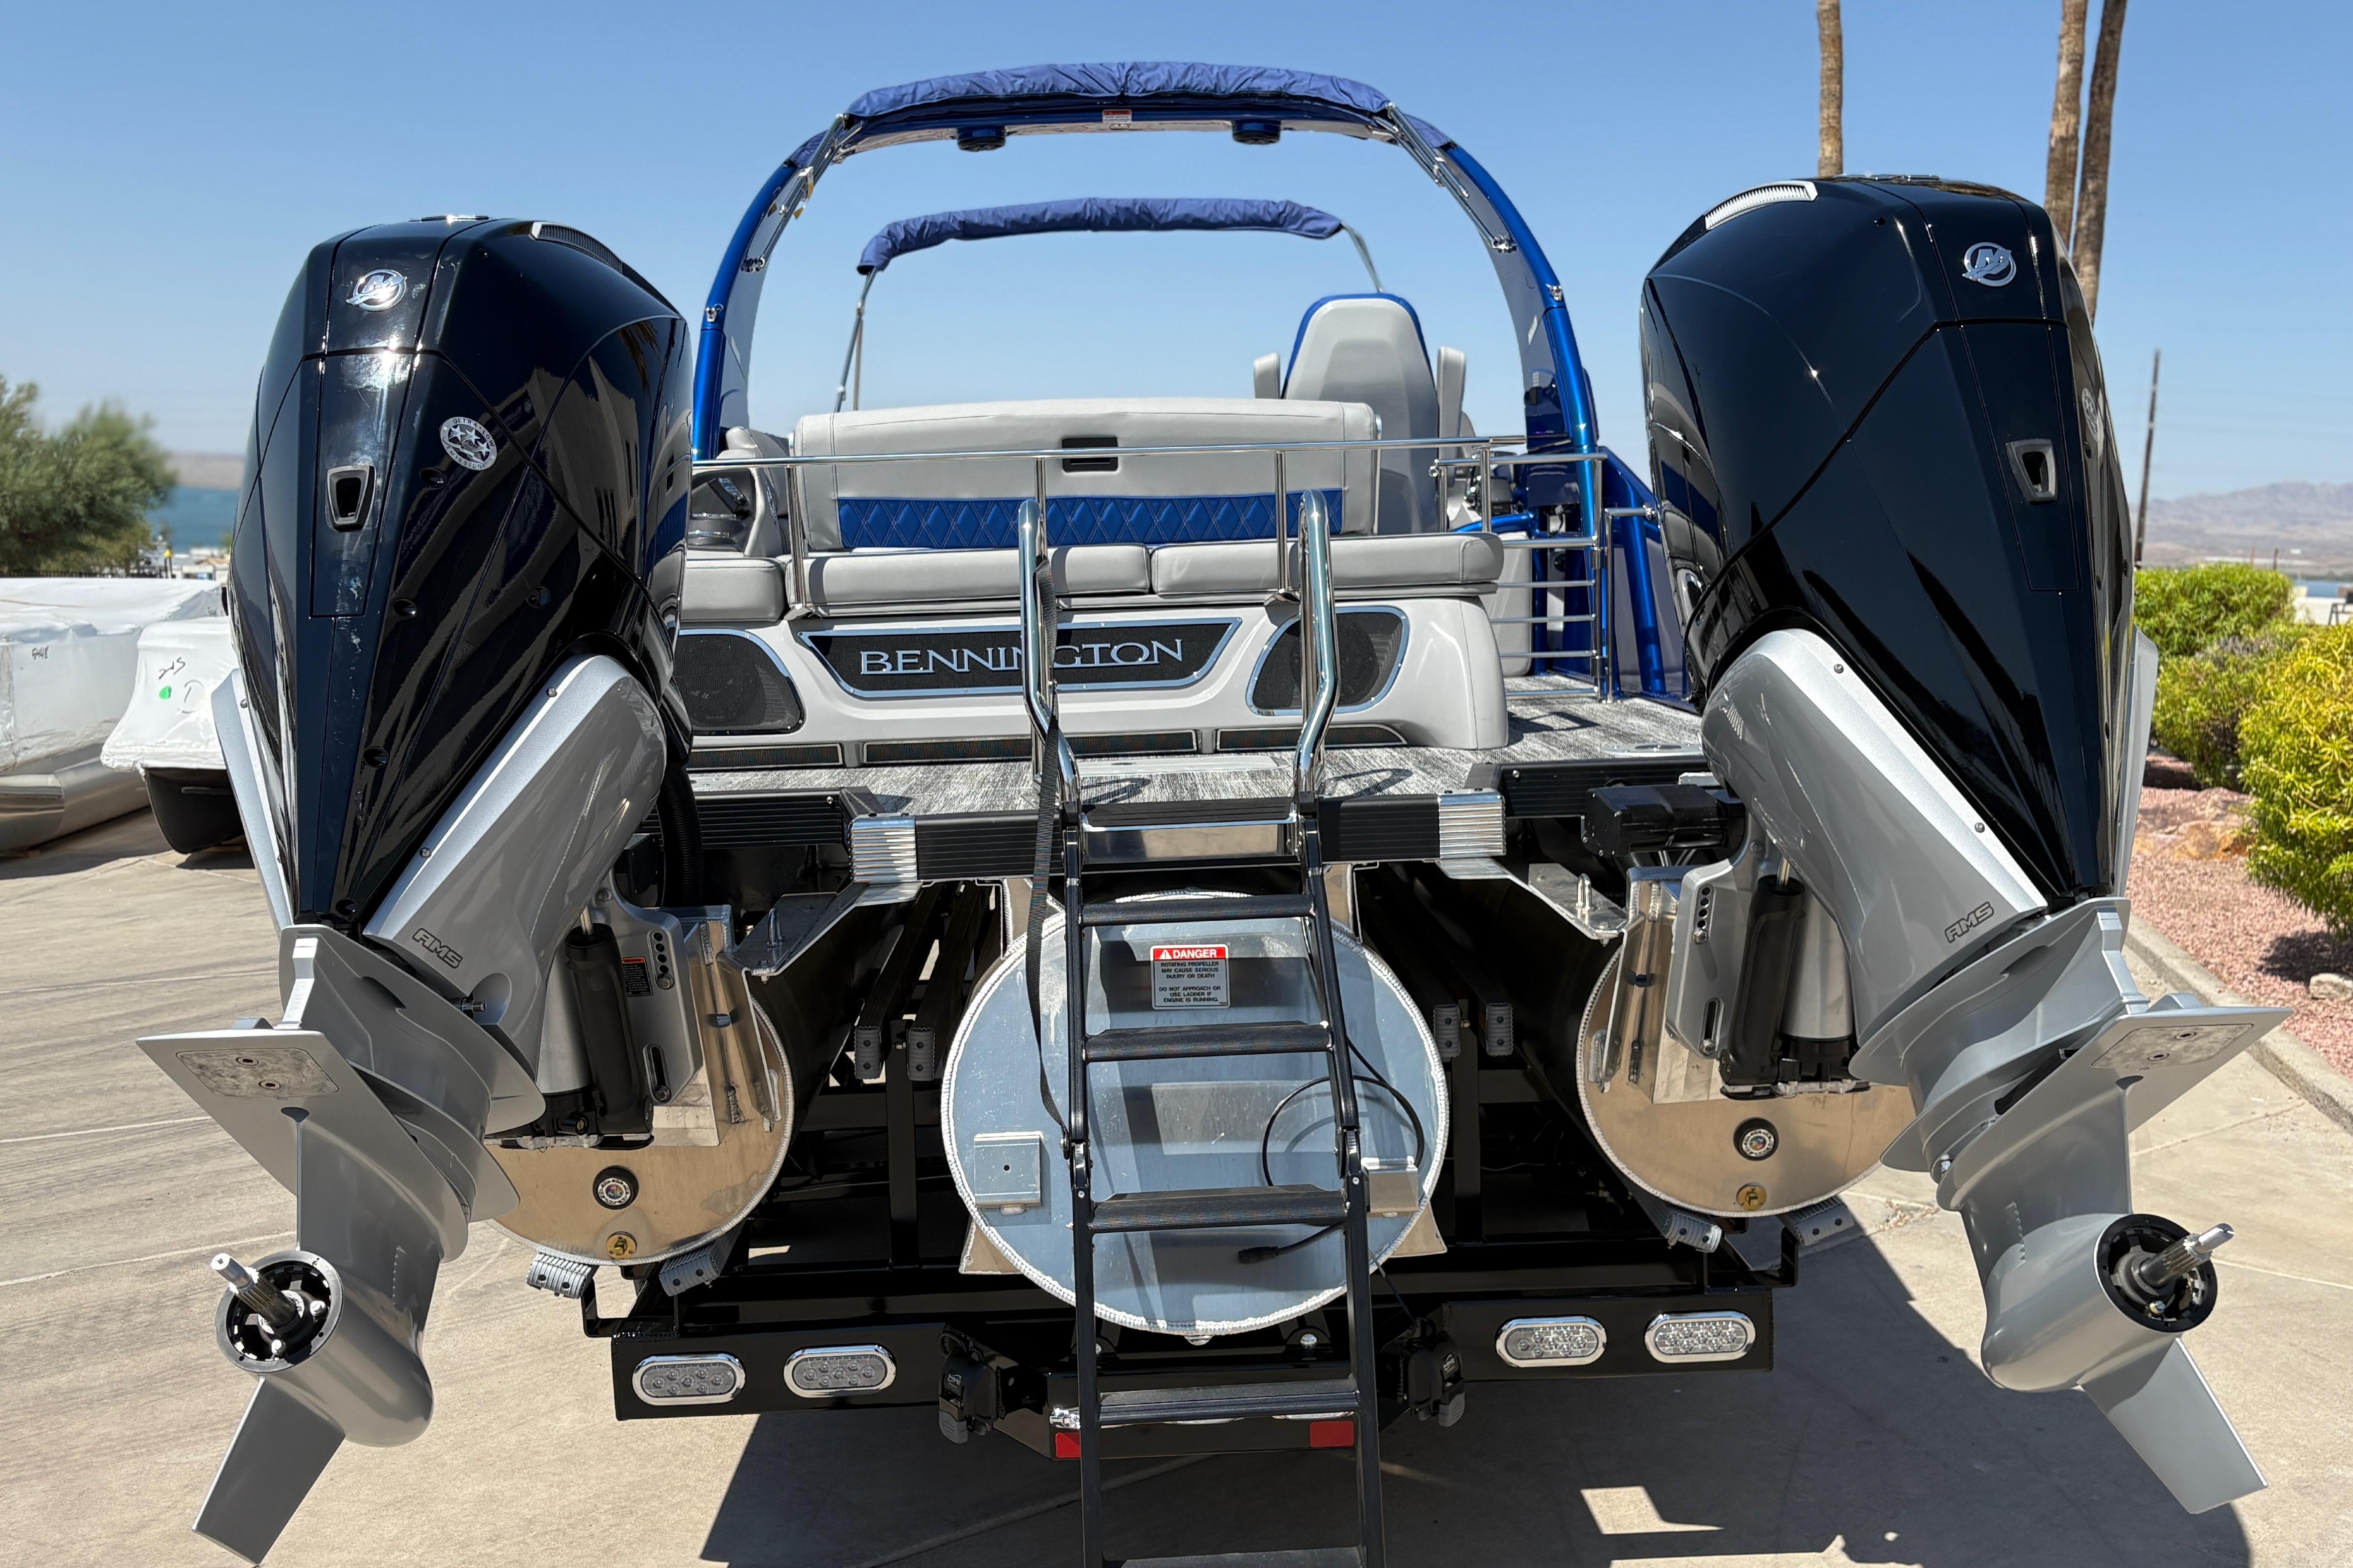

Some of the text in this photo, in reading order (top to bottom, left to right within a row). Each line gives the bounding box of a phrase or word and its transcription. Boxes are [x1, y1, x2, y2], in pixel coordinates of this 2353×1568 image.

[453, 418, 495, 447] ULTRA LOW
[32, 645, 49, 660] 5448
[1944, 901, 1994, 943] AMS
[412, 928, 463, 969] AMS
[1173, 949, 1217, 958] DANGER
